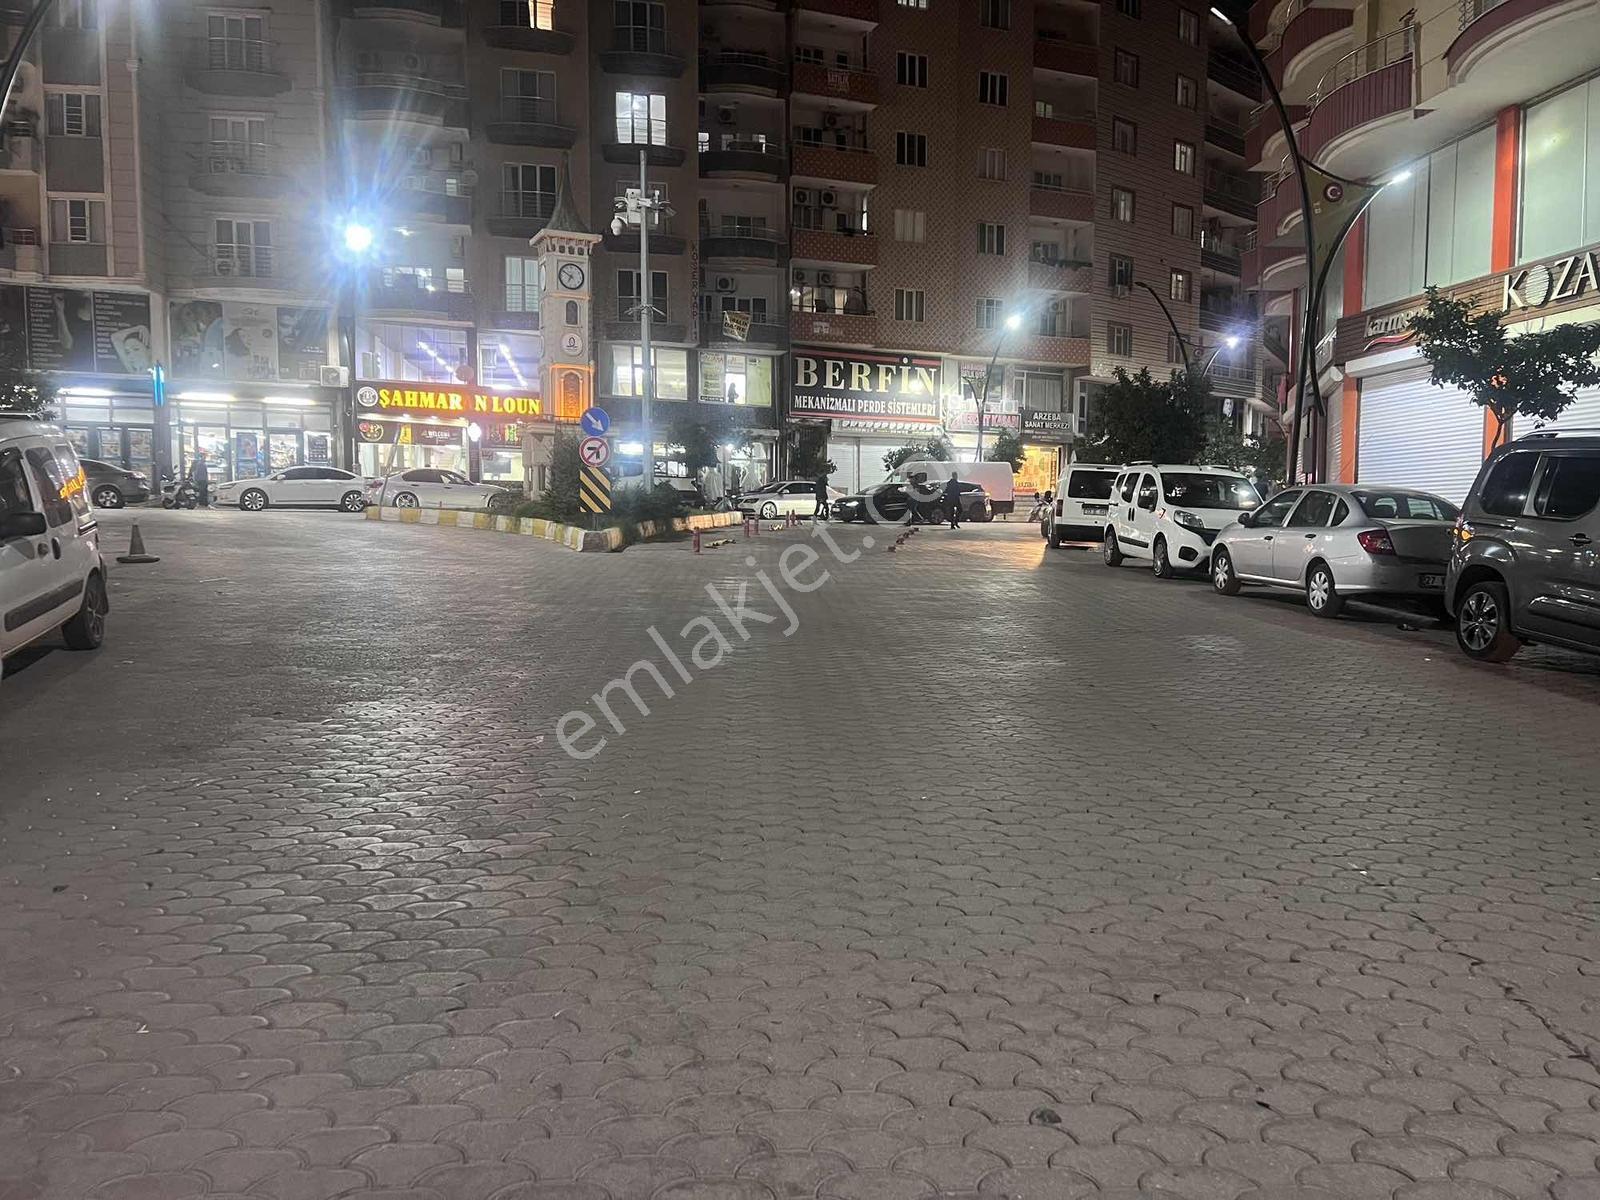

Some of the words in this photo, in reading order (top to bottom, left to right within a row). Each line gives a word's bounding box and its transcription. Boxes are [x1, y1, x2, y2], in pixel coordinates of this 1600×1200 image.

[1502, 251, 1599, 313] KOZA
[795, 357, 937, 396] BERFİN
[794, 393, 856, 412] MEKANİZMALI
[857, 399, 886, 415] PERDE
[887, 397, 936, 417] SİSTEMLERİ
[1024, 420, 1044, 429] SANAT
